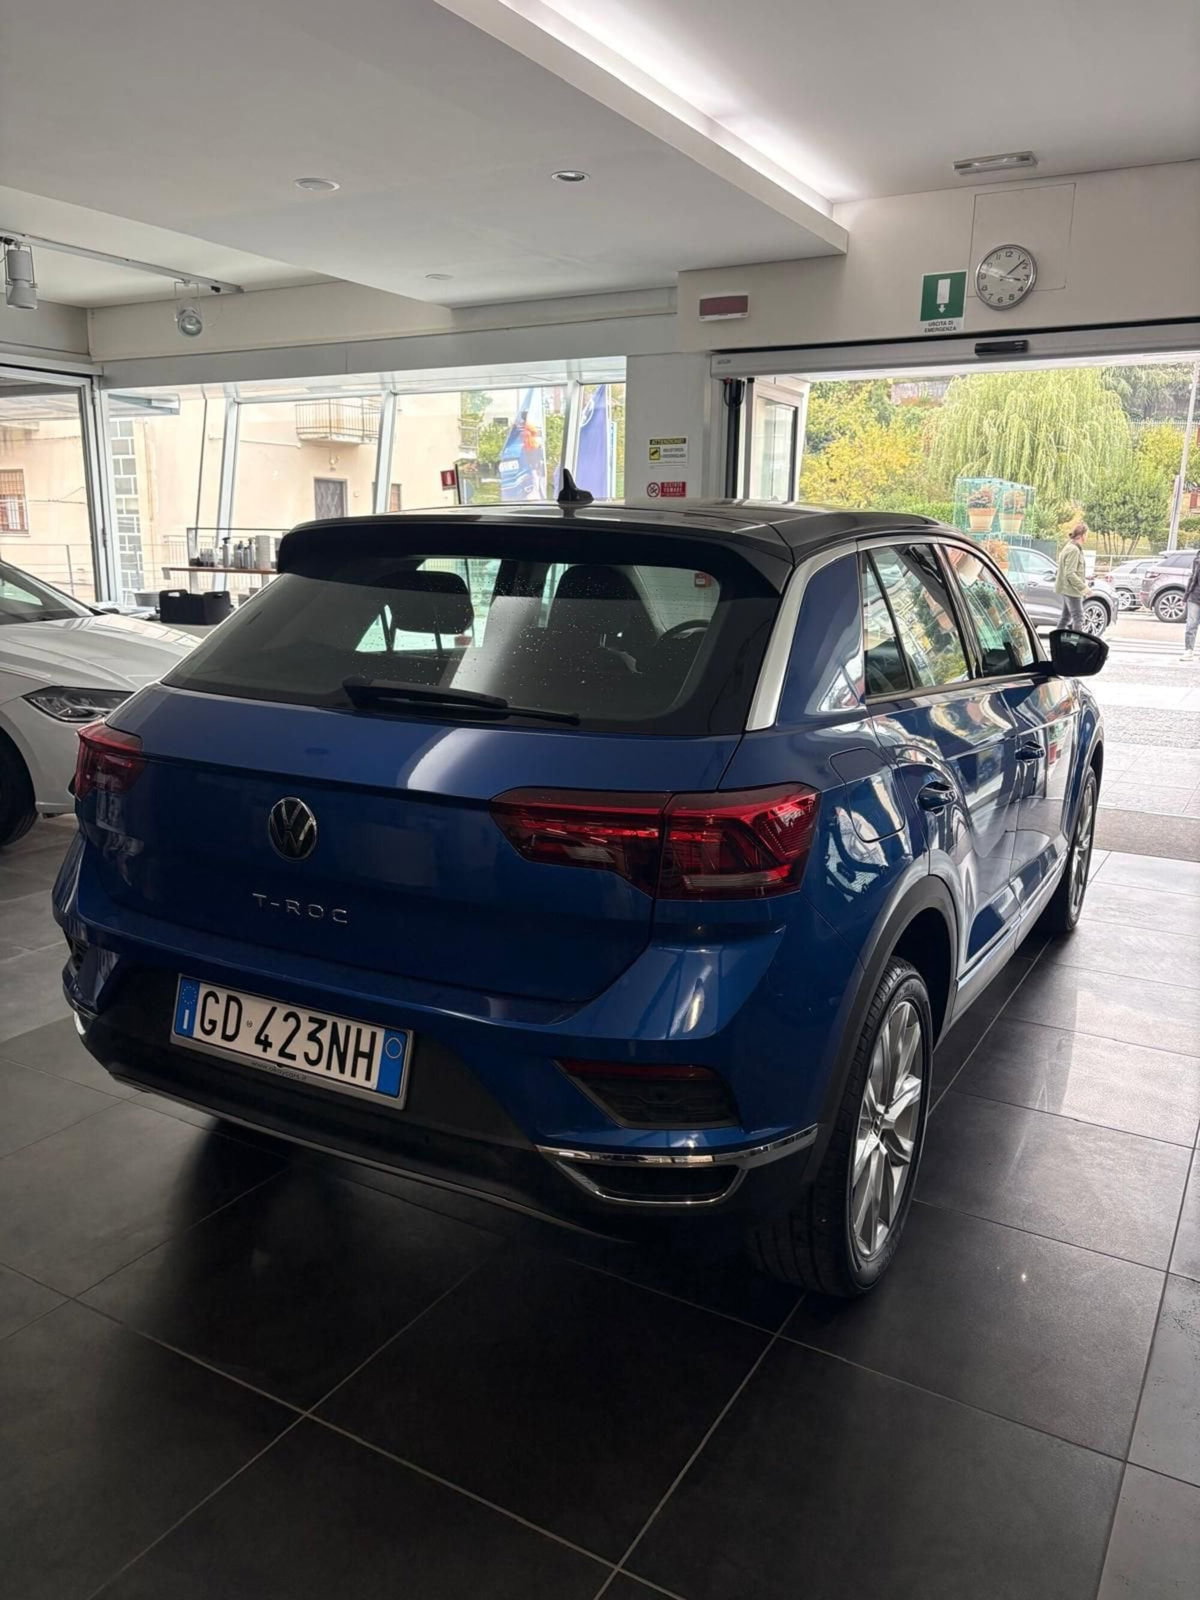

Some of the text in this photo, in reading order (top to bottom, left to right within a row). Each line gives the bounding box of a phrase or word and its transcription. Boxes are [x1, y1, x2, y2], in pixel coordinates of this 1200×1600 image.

[252, 893, 348, 923] T-ROC
[199, 990, 377, 1082] GD 423NH
